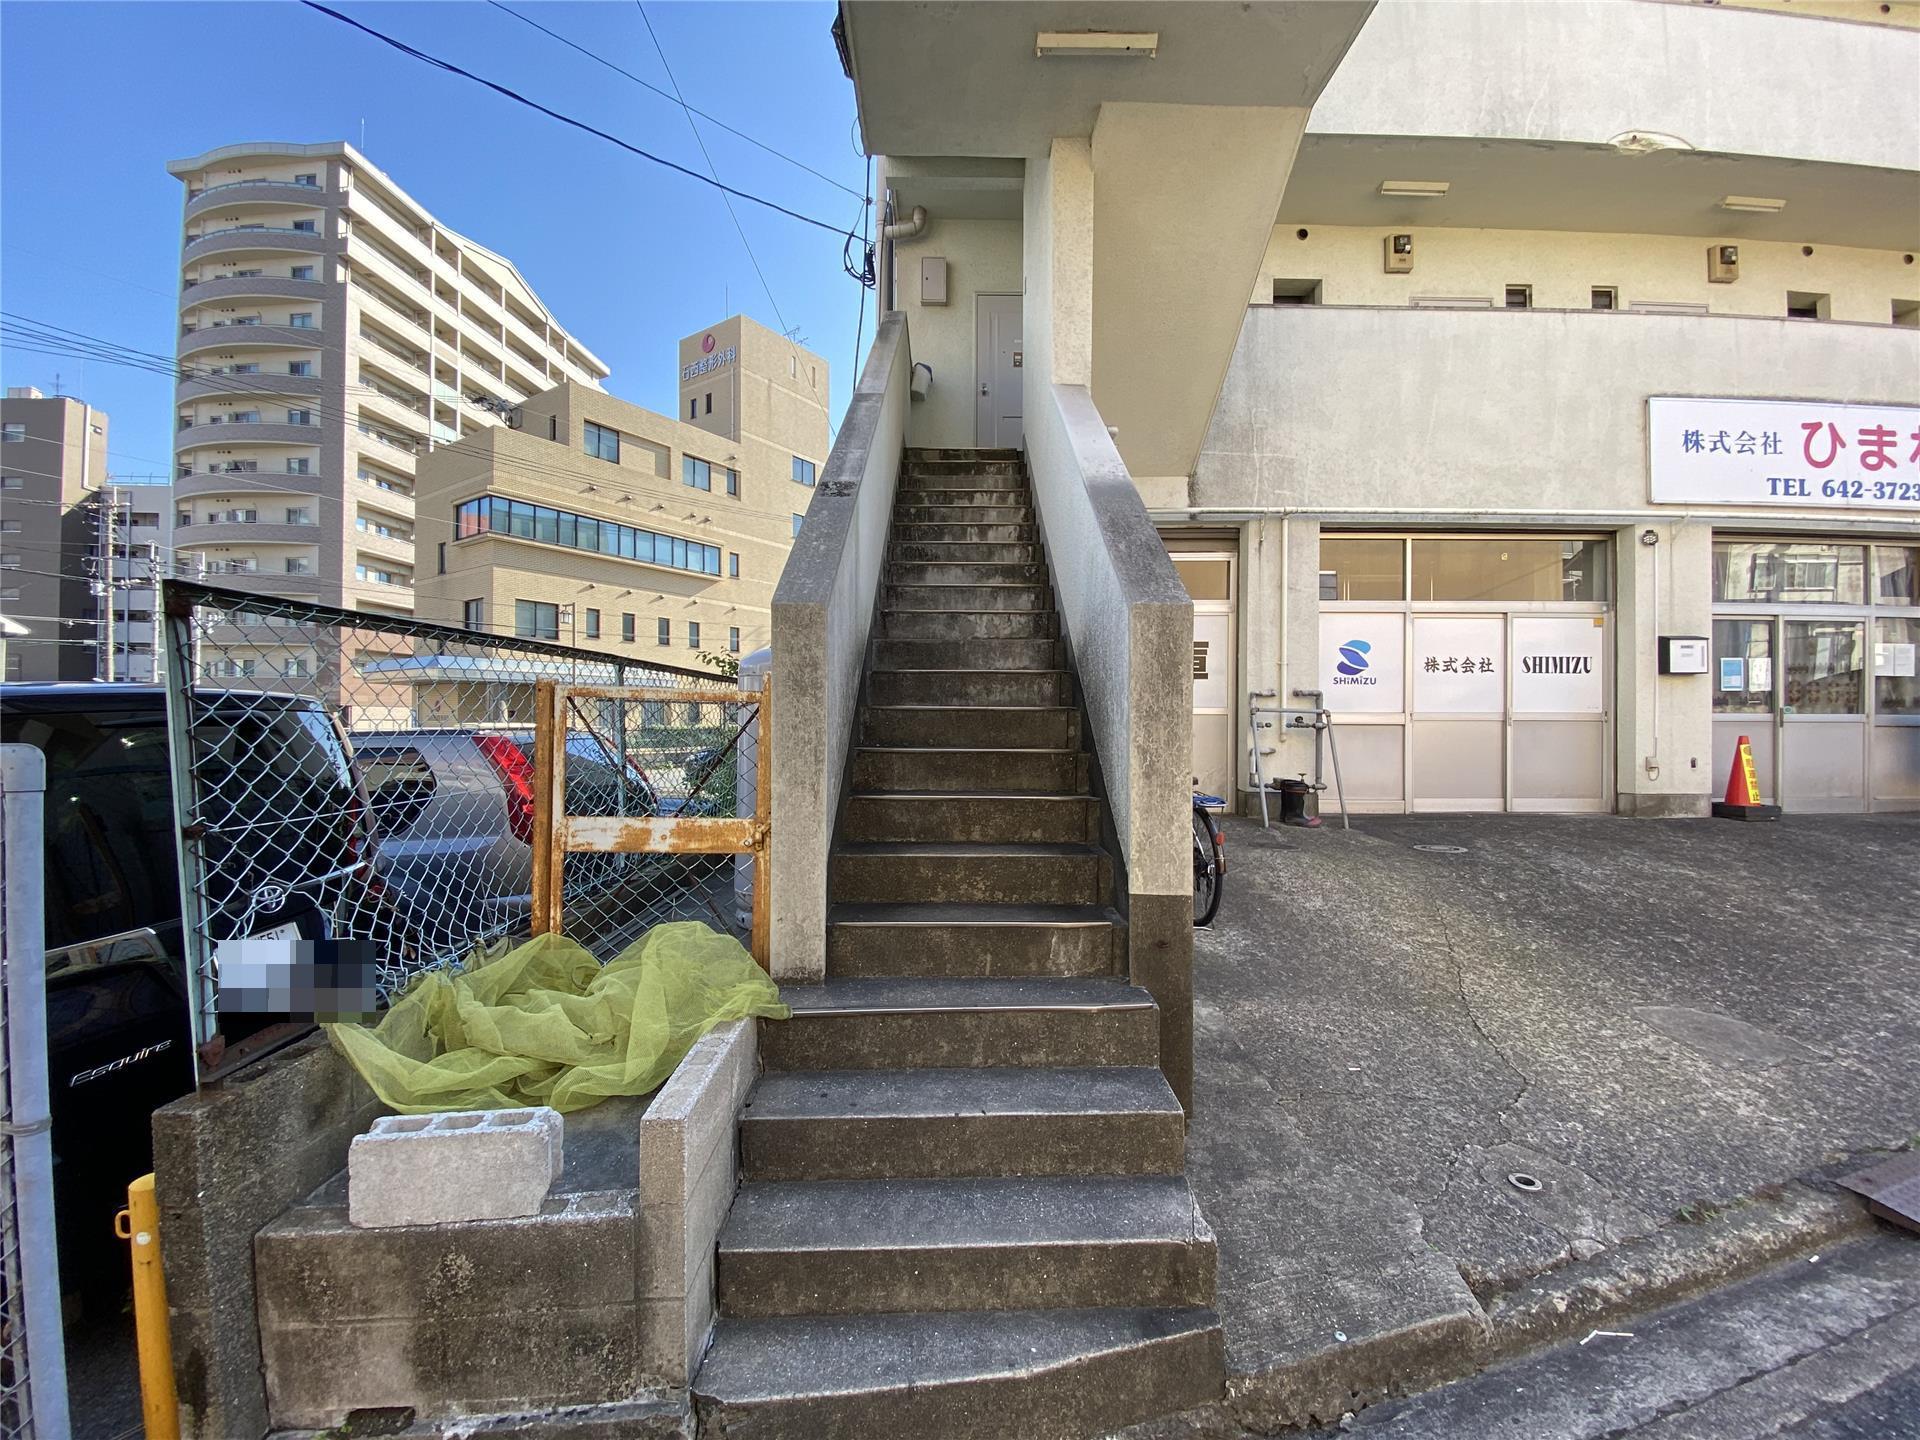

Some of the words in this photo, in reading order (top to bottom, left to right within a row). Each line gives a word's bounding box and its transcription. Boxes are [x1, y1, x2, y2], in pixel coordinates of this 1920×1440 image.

[1682, 429, 1784, 456] 株式会社
[1801, 421, 1920, 472] ひま
[1766, 477, 1811, 497] TEL
[1423, 655, 1495, 675] 株式会社
[1521, 655, 1594, 676] SHIMIZU
